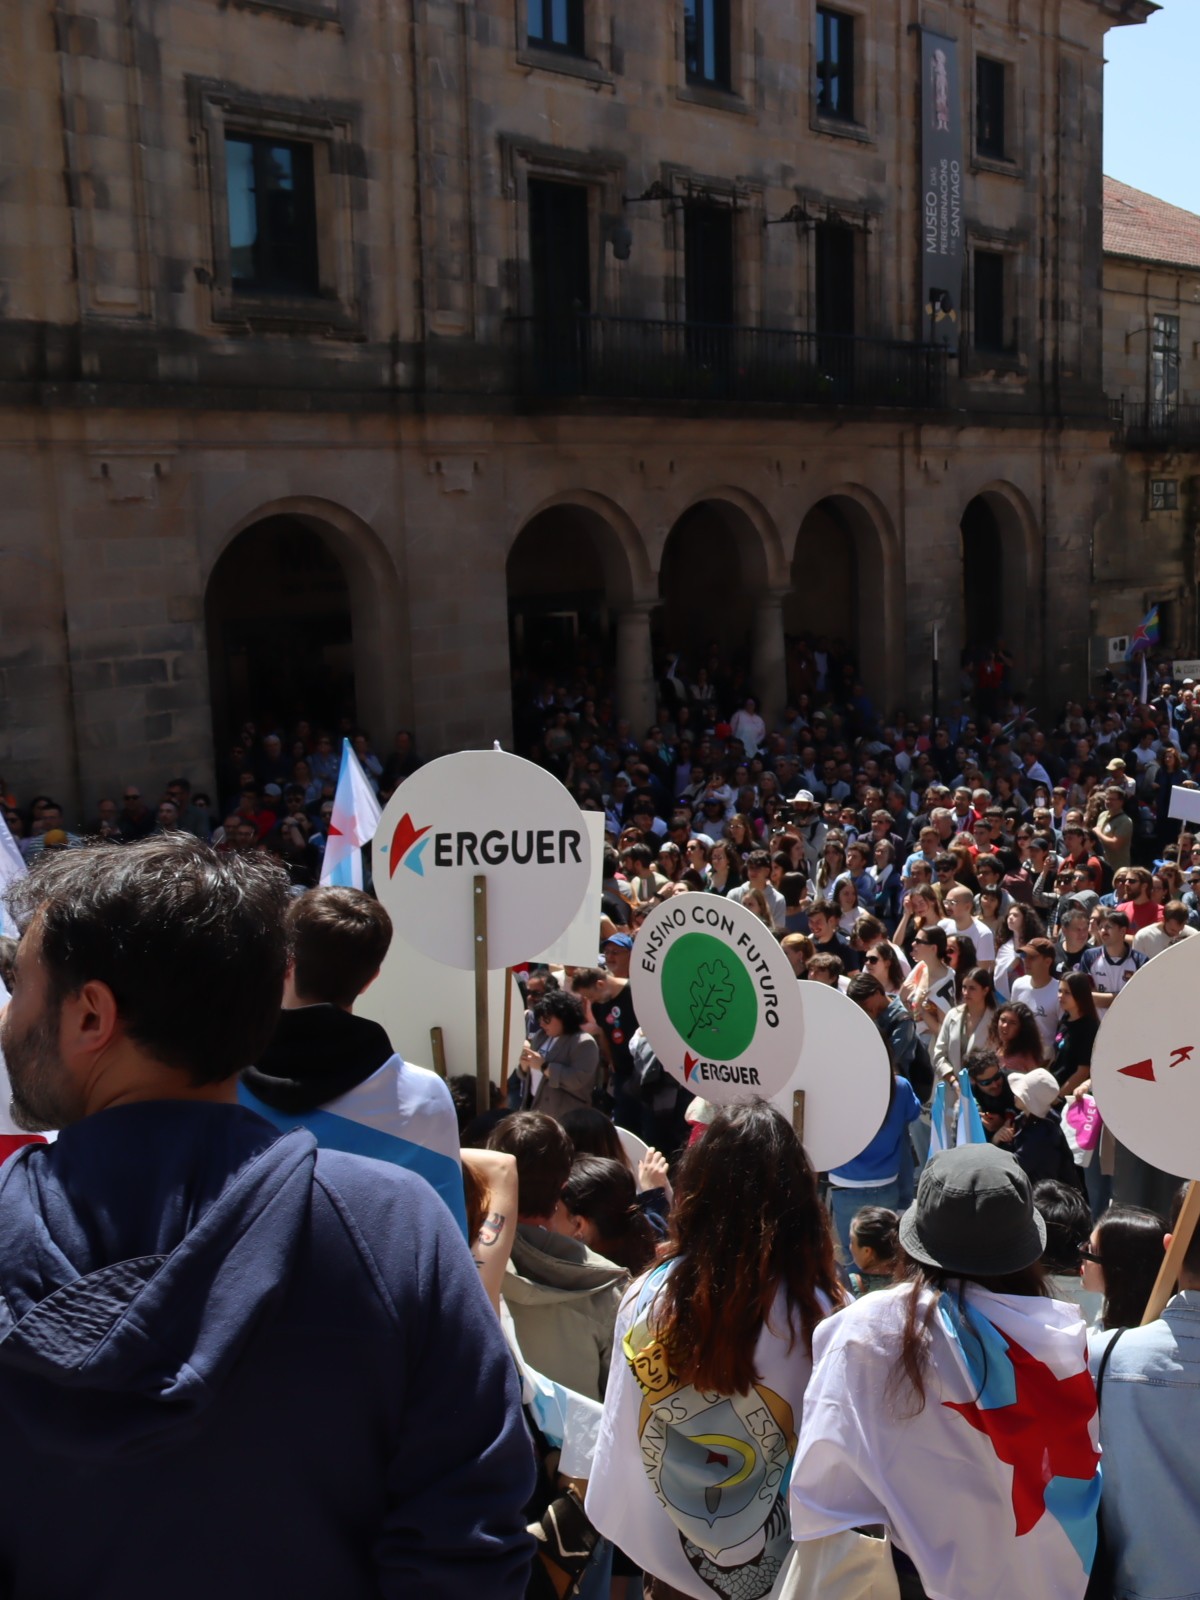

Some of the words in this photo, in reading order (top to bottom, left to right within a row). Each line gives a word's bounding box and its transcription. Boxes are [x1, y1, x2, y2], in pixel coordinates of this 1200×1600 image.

[926, 192, 937, 253] MUSEO
[940, 159, 948, 254] PEREGRINACIÓNS
[951, 161, 960, 237] SANTIAGO
[434, 829, 583, 868] ERGUER
[642, 908, 686, 973] ENSINO
[692, 906, 735, 936] CON
[737, 932, 780, 1028] FUTURO
[700, 1062, 761, 1086] ERGUER
